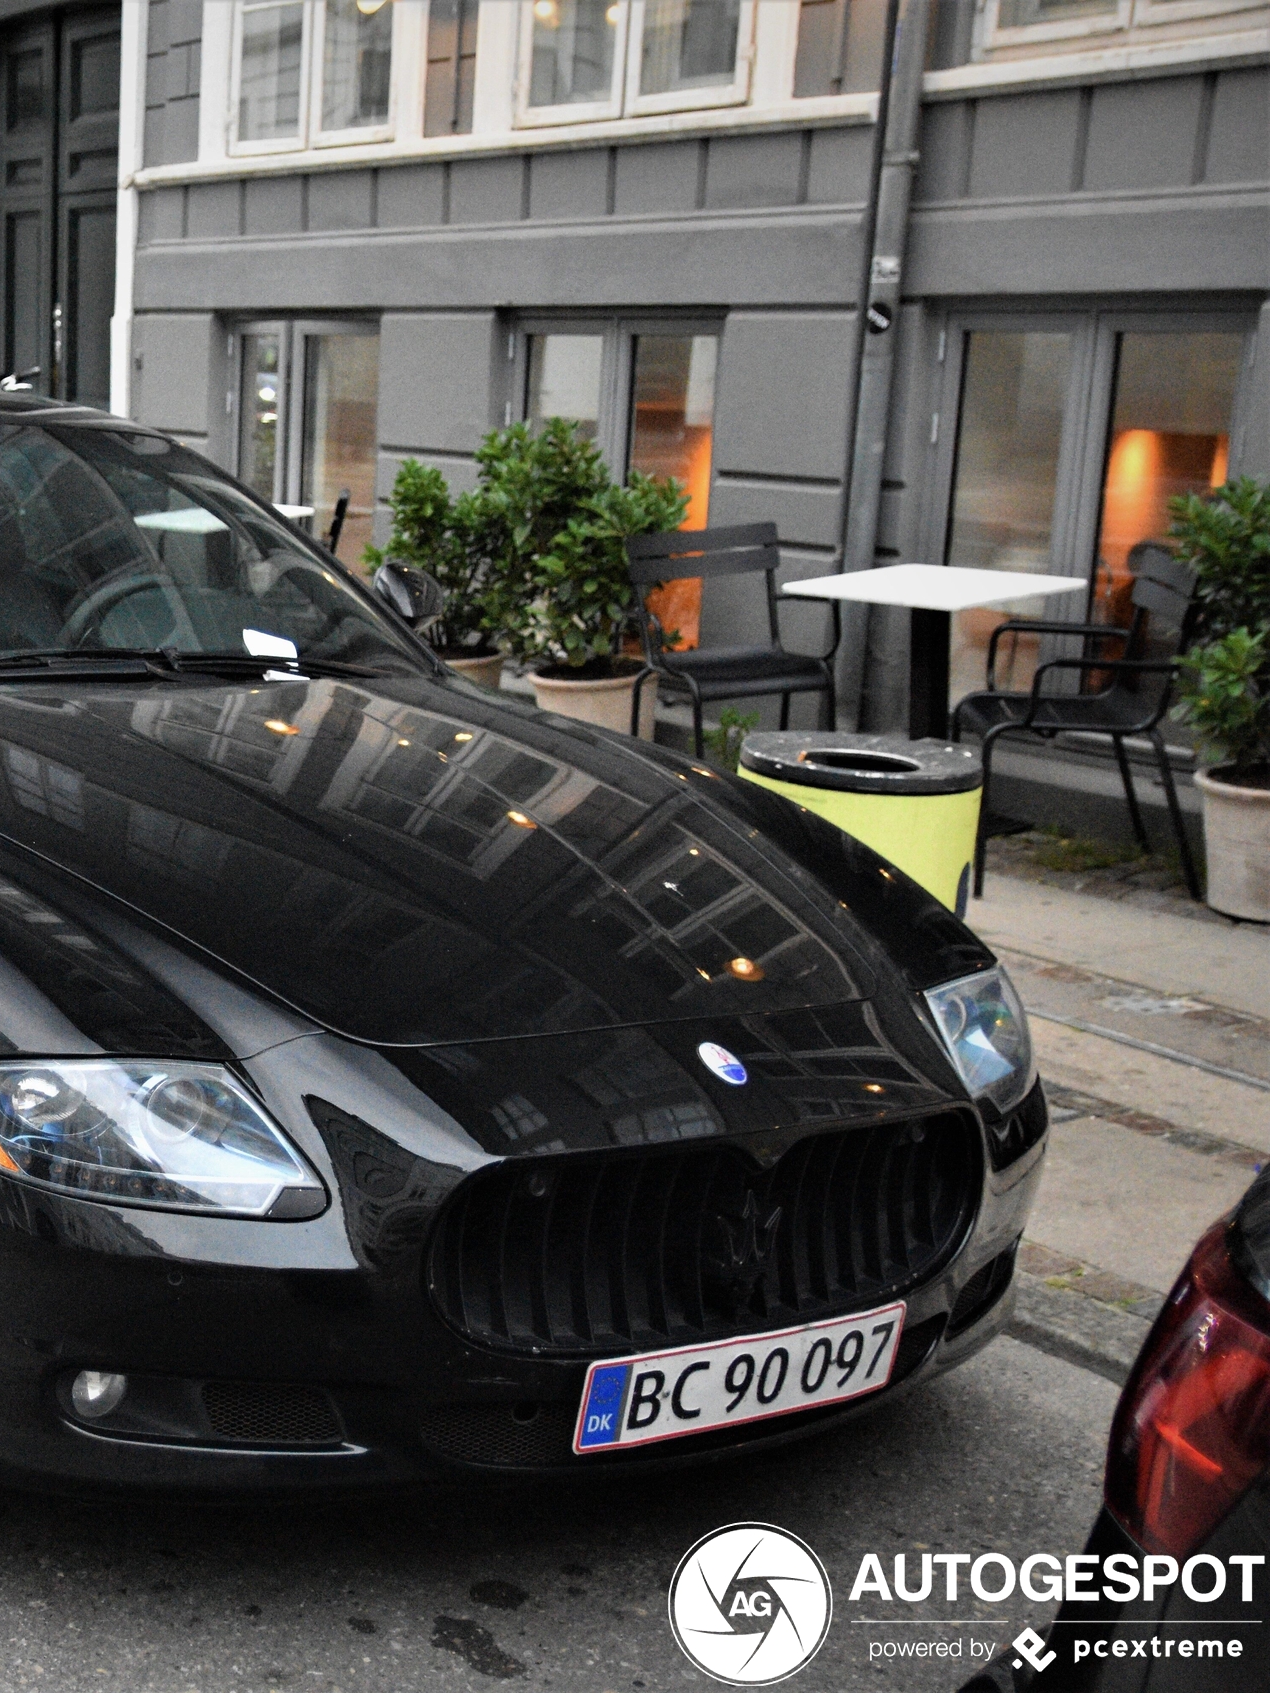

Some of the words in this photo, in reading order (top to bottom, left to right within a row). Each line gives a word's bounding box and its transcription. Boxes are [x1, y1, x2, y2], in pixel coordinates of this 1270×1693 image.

[626, 1361, 711, 1431] BC
[724, 1347, 790, 1414] 90
[800, 1320, 895, 1394] 097
[587, 1413, 613, 1433] DK
